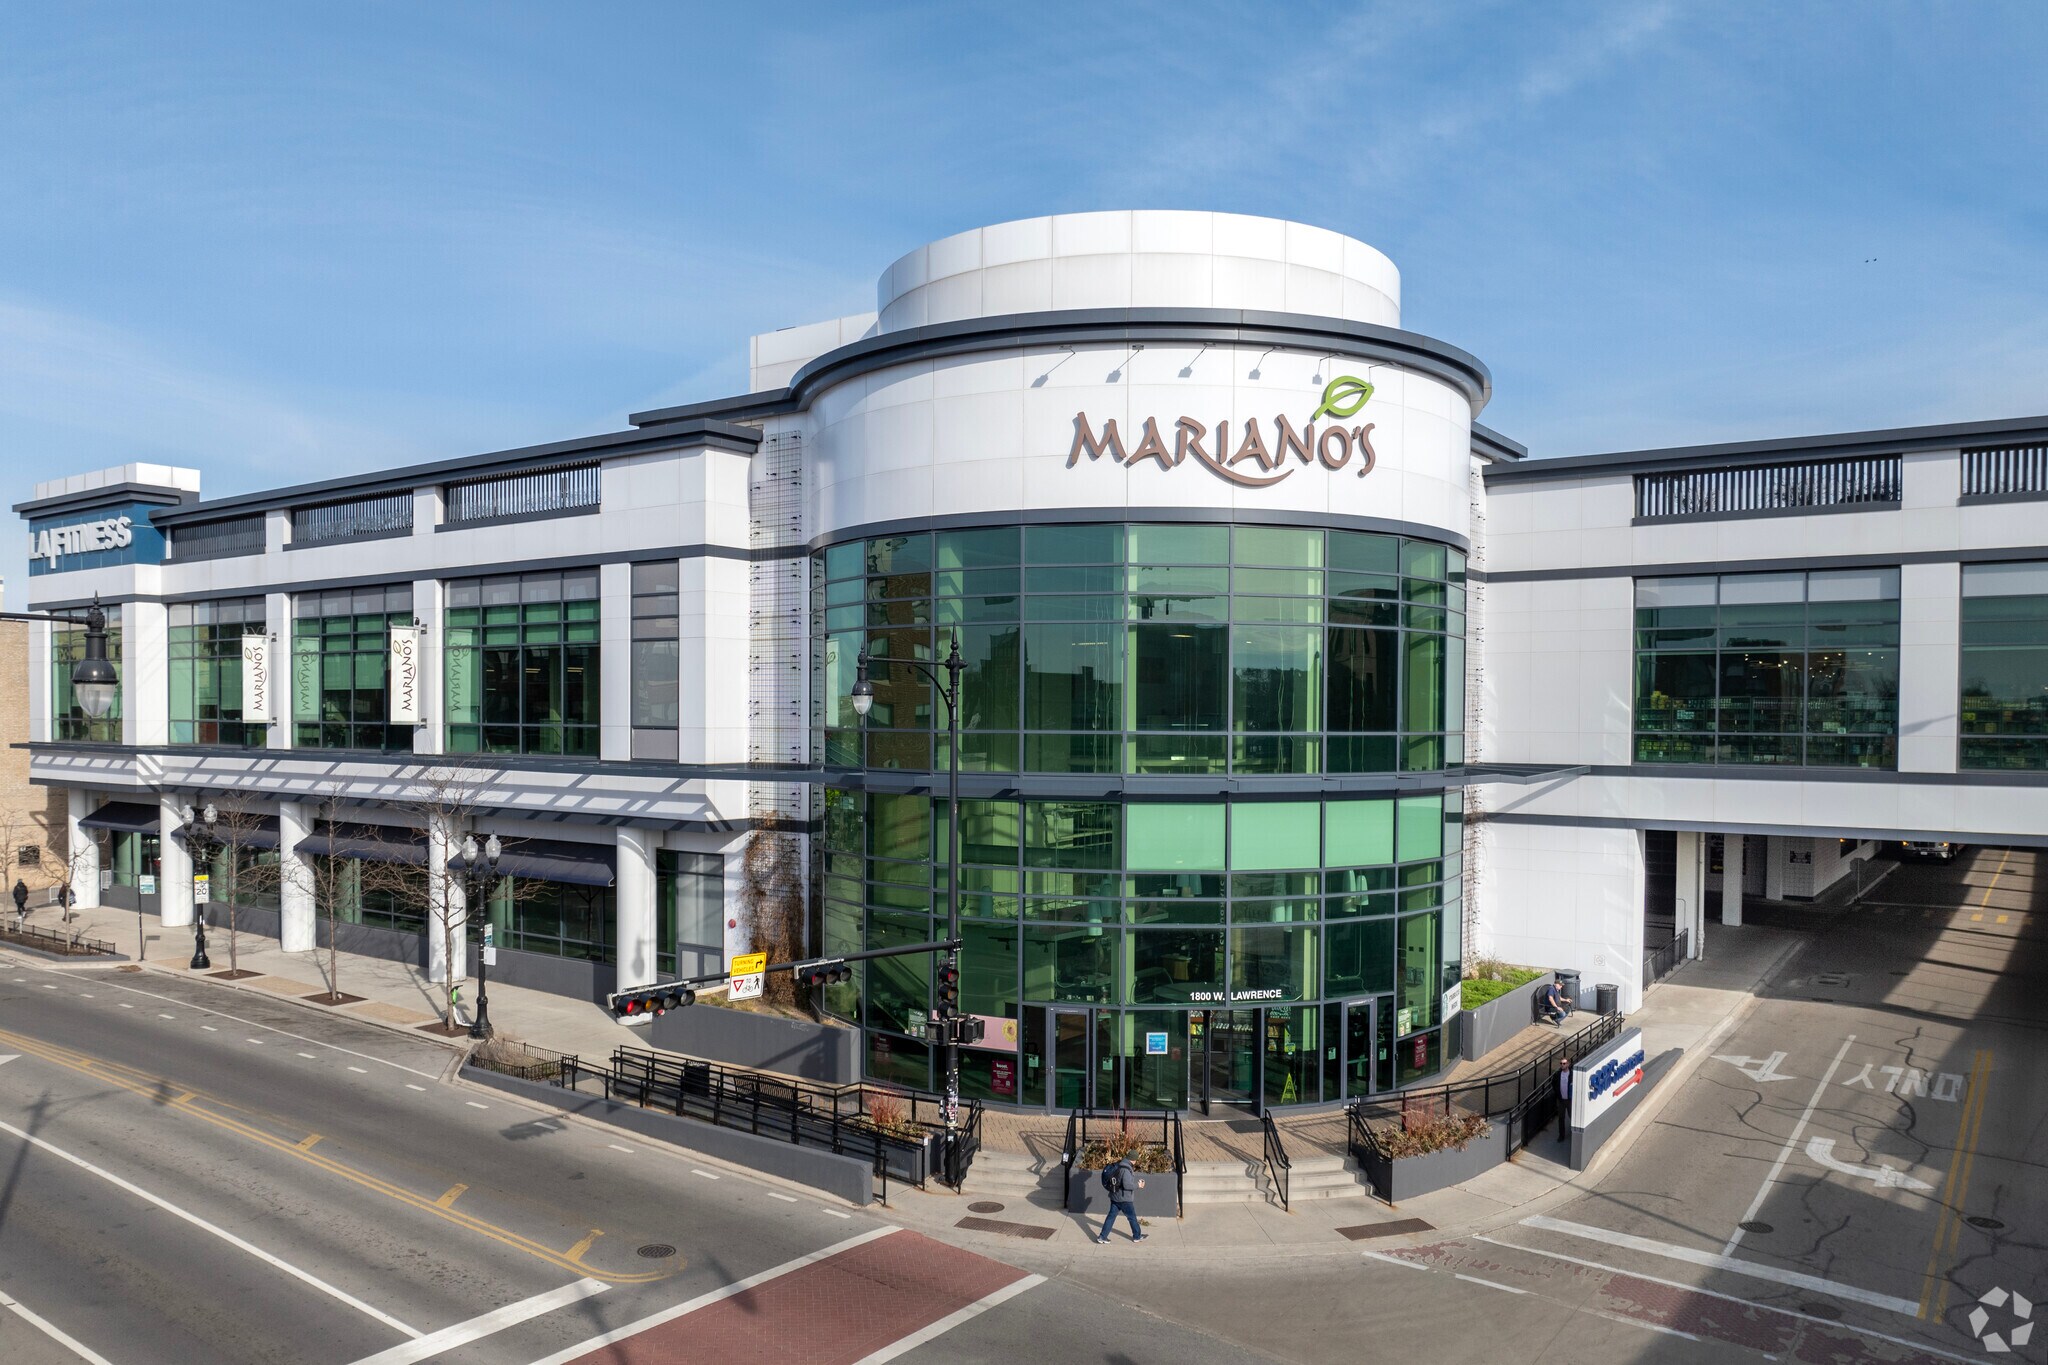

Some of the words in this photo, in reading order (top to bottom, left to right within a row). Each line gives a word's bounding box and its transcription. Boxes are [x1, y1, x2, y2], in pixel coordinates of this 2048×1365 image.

[1070, 411, 1376, 487] MARIANO'S
[29, 530, 51, 559] LA
[50, 516, 132, 569] FITNESS
[253, 646, 267, 711] MARIANO'S
[402, 639, 416, 711] MARIANO'S
[1189, 991, 1211, 1001] 1800
[1213, 992, 1226, 1001] W.
[1230, 989, 1282, 1001] LAWRENCE
[1841, 1063, 1965, 1103] ONLY
